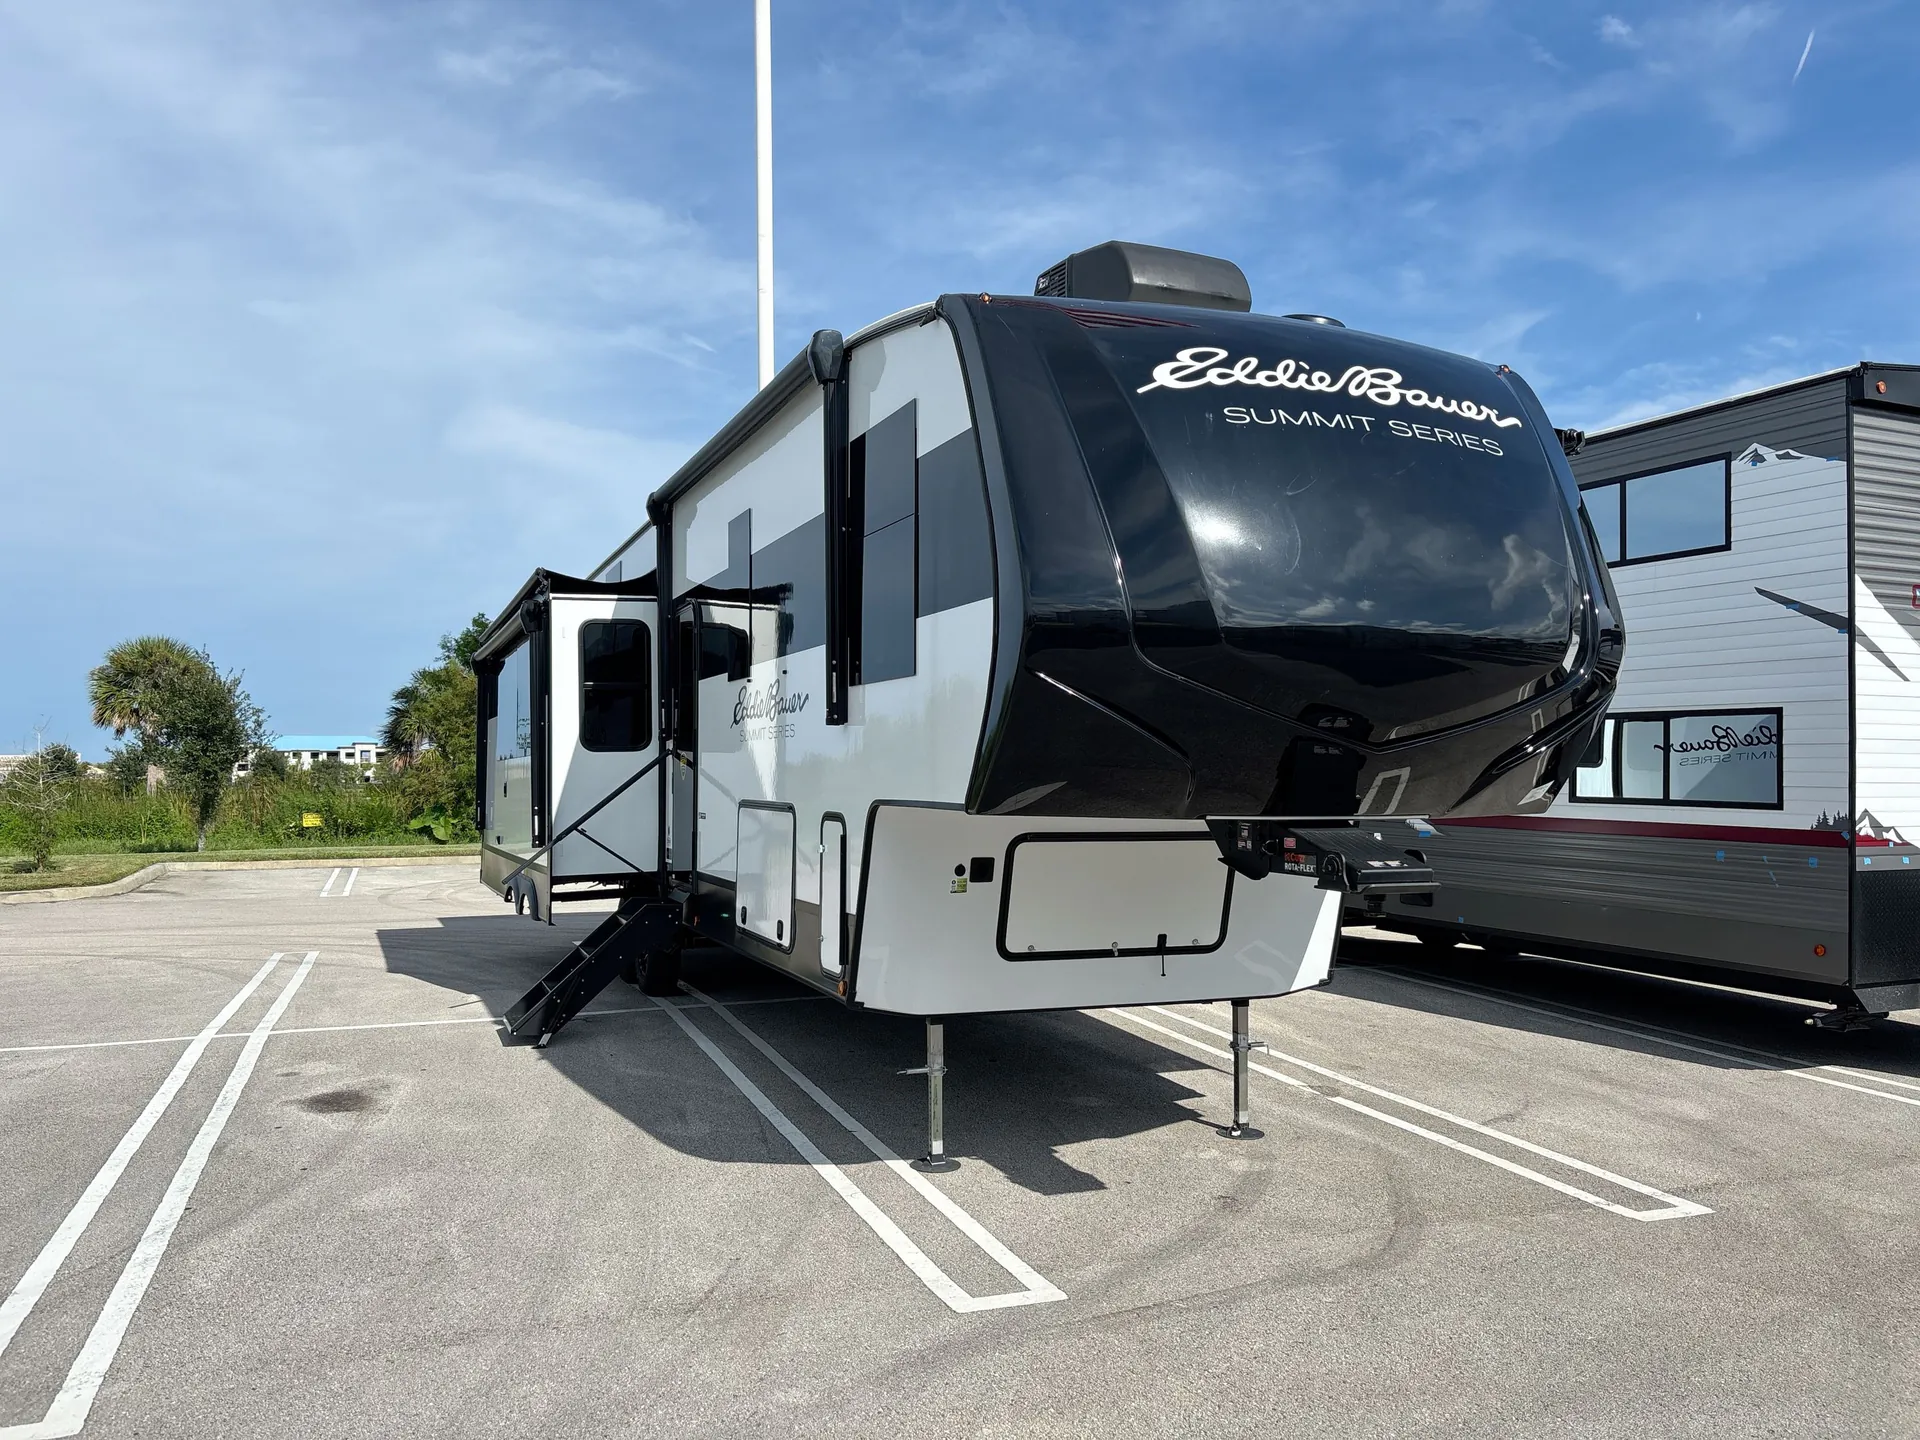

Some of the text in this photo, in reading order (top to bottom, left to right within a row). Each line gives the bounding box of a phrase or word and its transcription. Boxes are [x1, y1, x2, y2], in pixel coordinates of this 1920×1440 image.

[1137, 346, 1522, 428] Eddie Bauer
[1223, 406, 1504, 457] SUMMIT SERIES
[730, 678, 809, 729] Eddie Bauer
[768, 723, 796, 740] SERIES
